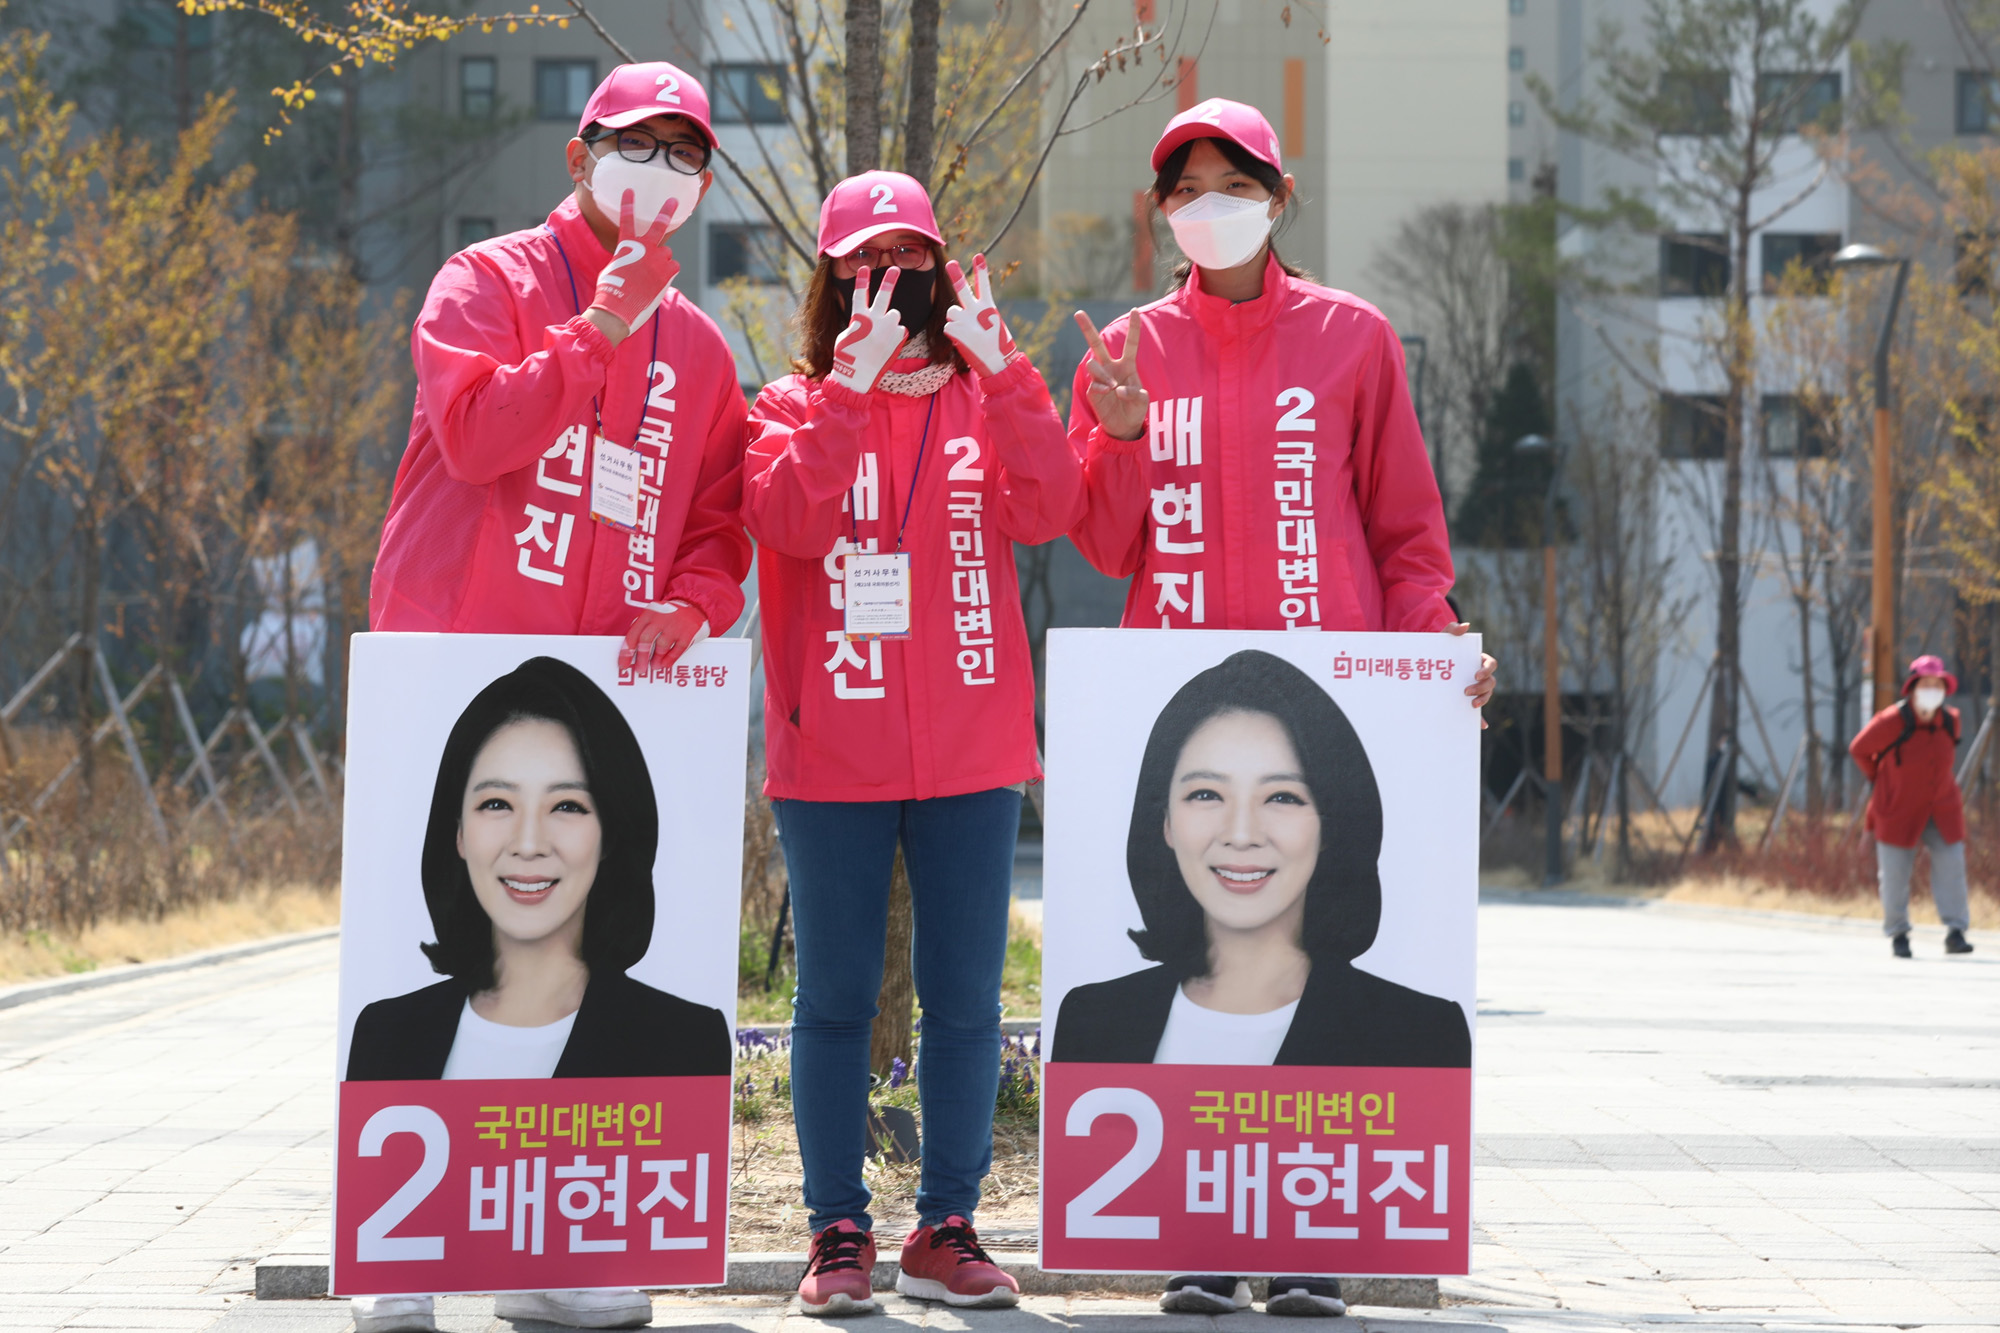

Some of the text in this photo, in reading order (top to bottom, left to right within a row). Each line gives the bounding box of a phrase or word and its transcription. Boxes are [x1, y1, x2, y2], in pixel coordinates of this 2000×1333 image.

[654, 73, 681, 104] 2
[1198, 102, 1222, 125] 2
[869, 184, 898, 215] 2
[597, 239, 646, 288] 2
[835, 313, 873, 365] 2
[644, 360, 676, 412] 2
[1150, 396, 1204, 629] 배현진
[1273, 386, 1322, 631] 2 국민대변인
[944, 436, 995, 685] 2 국민대변인
[638, 665, 728, 687] 미래통합당
[1355, 658, 1455, 681] 미래통합당
[474, 1102, 663, 1150] 국민대변인
[1190, 1090, 1396, 1136] 국민대변인
[356, 1105, 450, 1262] 2
[1065, 1086, 1164, 1239] 2
[469, 1153, 710, 1256] 배현진
[1185, 1142, 1449, 1240] 배현진
